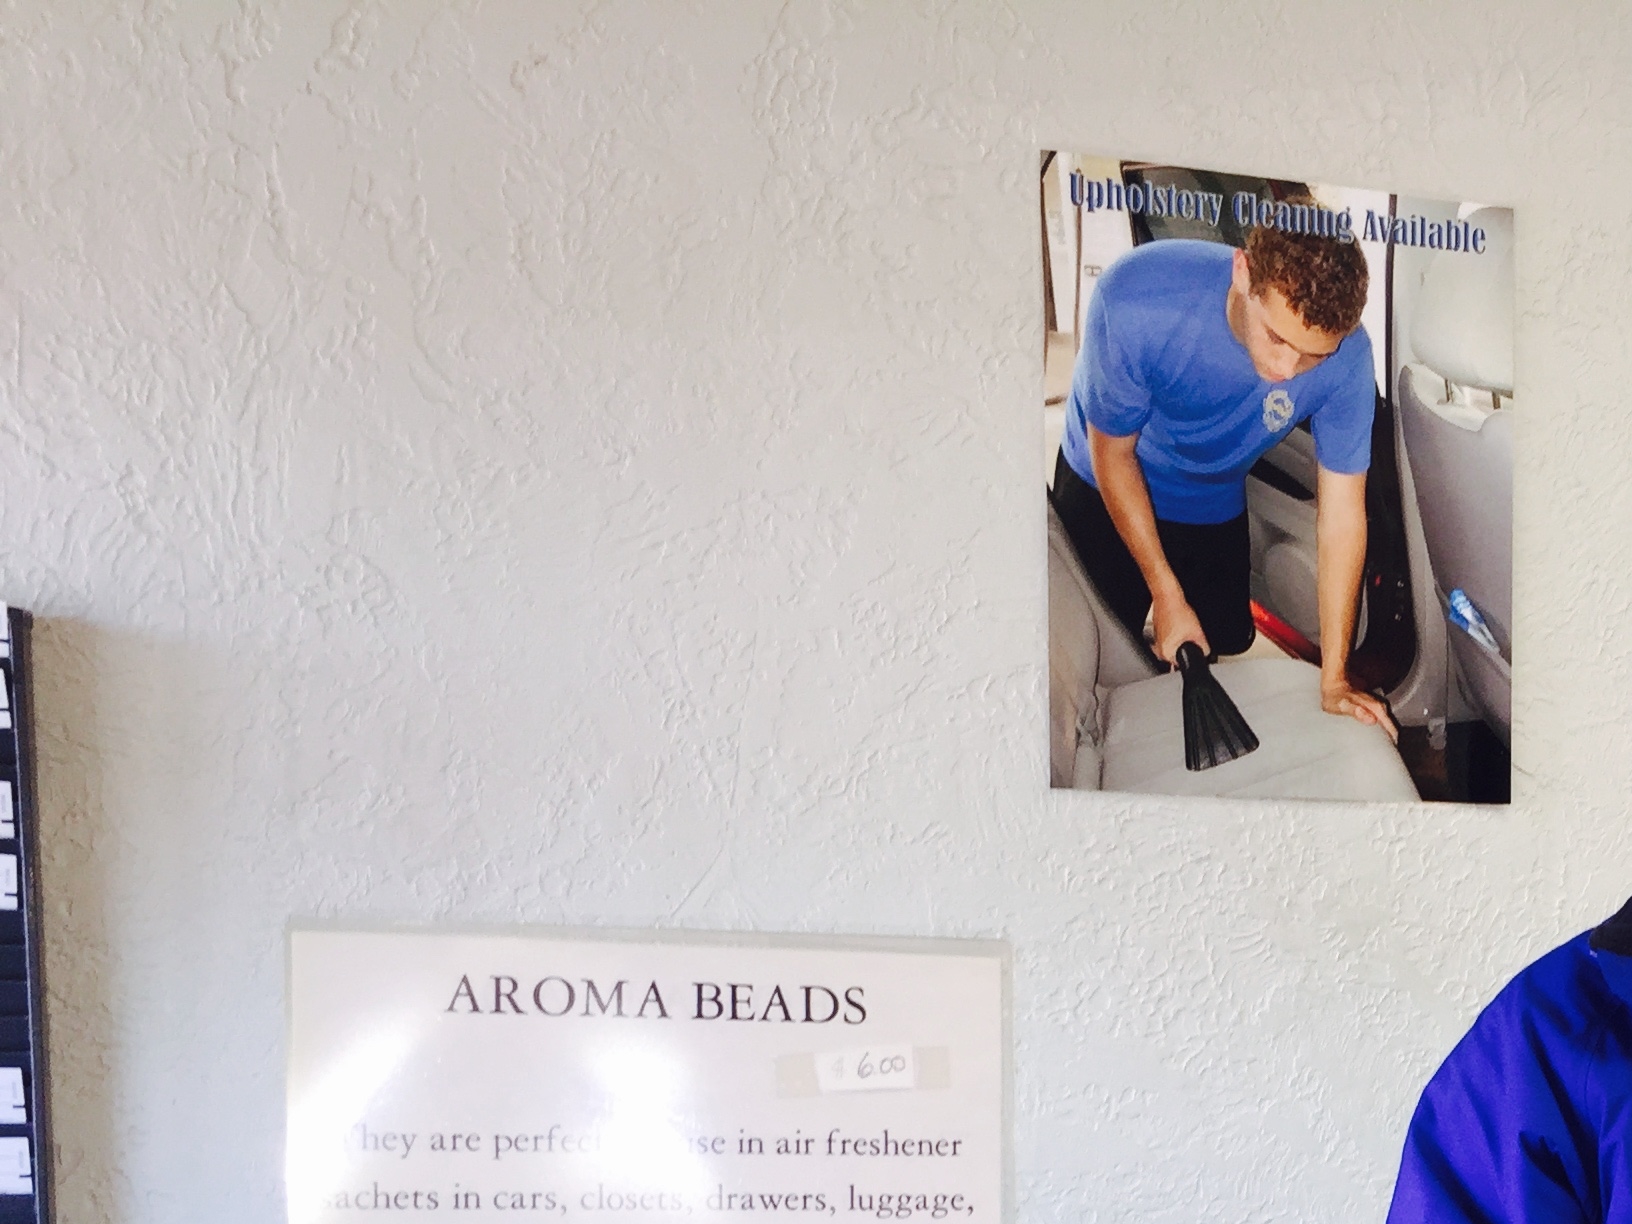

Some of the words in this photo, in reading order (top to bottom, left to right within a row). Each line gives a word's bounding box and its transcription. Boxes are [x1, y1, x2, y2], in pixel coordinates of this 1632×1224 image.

[1070, 171, 1224, 228] Upholstery
[1232, 190, 1354, 243] Cleaning
[1363, 208, 1487, 255] Available
[443, 972, 673, 1018] AROMA
[691, 981, 868, 1026] BEADS
[346, 1122, 418, 1160] hey
[429, 1130, 482, 1153] are
[737, 1127, 765, 1155] in
[775, 1128, 816, 1158] air
[825, 1128, 963, 1158] freshener
[452, 1182, 482, 1211] in
[492, 1187, 568, 1217] cars,
[579, 1182, 694, 1216] closets,
[705, 1183, 837, 1217] drawers,
[848, 1184, 975, 1221] luggage,
